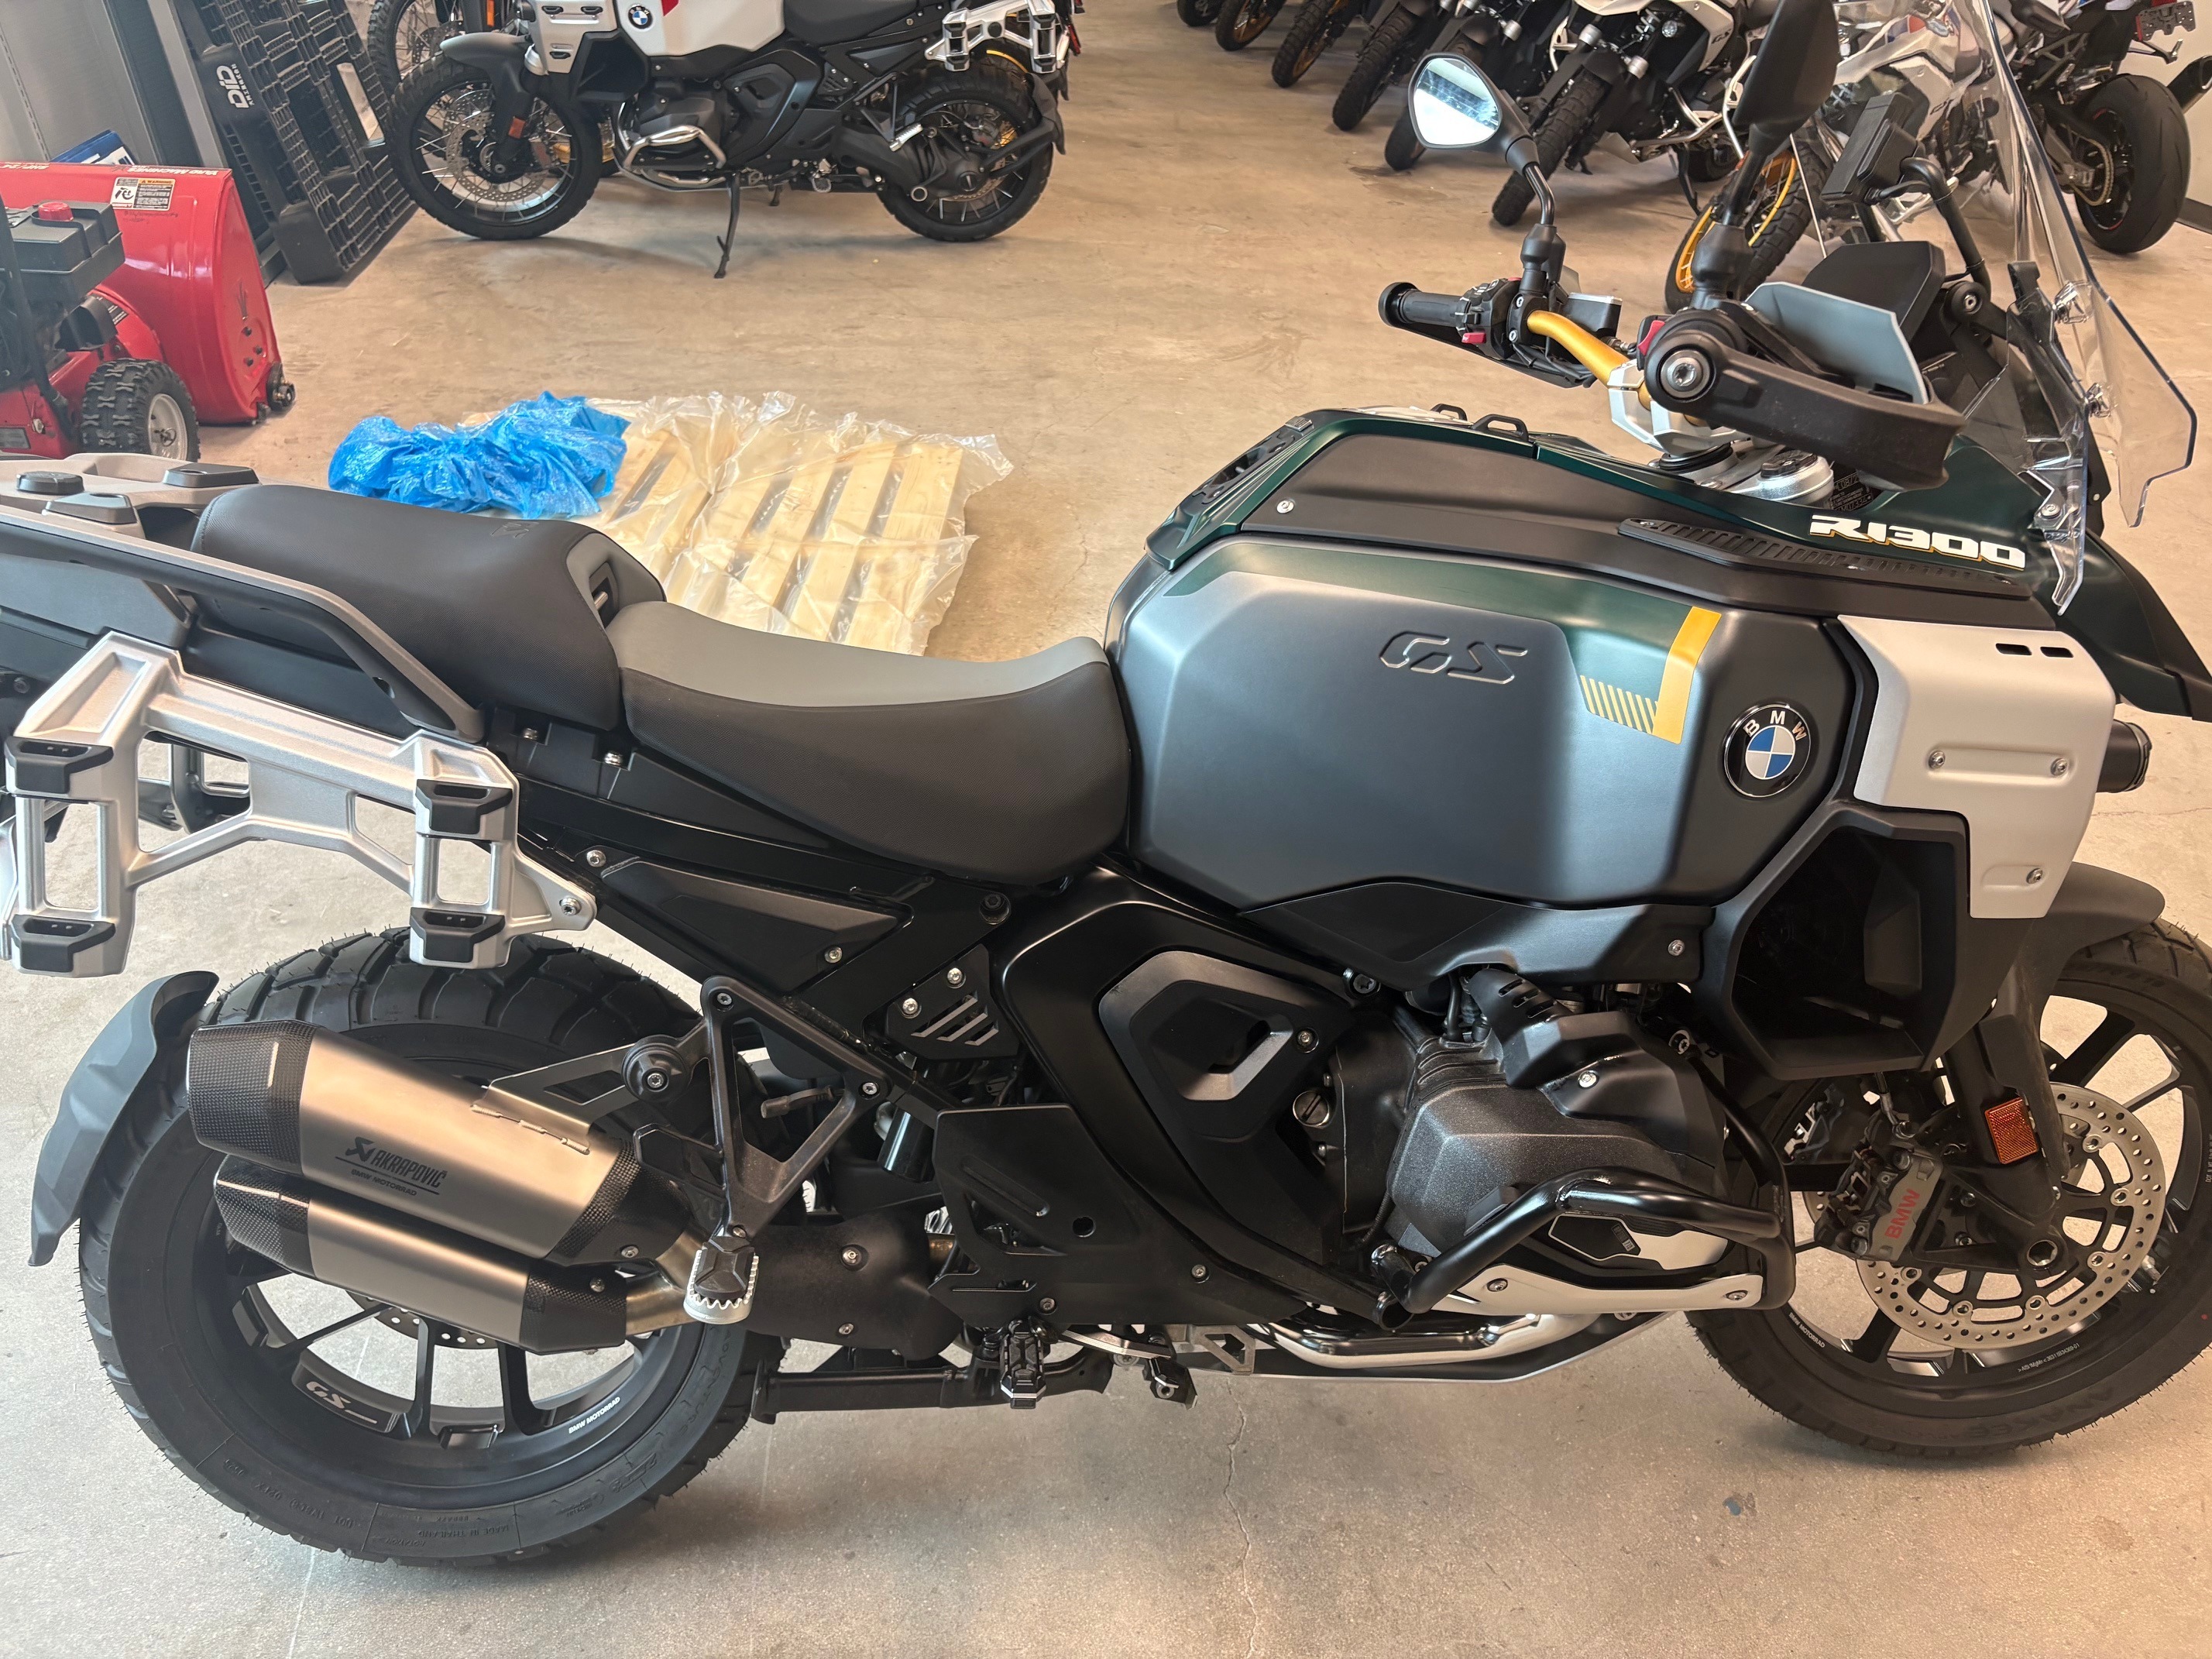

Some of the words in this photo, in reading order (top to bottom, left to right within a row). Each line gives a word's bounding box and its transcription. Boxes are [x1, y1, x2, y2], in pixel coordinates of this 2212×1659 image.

[1809, 514, 2025, 571] R1300
[1379, 630, 1528, 685] GS
[1743, 710, 1807, 741] BMW
[351, 1169, 373, 1180] BMW
[373, 1176, 417, 1196] MOTORRAD
[1884, 1188, 1920, 1239] BMW
[1788, 1312, 1801, 1326] BMW
[1799, 1324, 1826, 1348] MOTORRAD
[306, 1381, 352, 1409] GS
[568, 1420, 586, 1434] BMW
[586, 1396, 620, 1424] MOTORRAD
